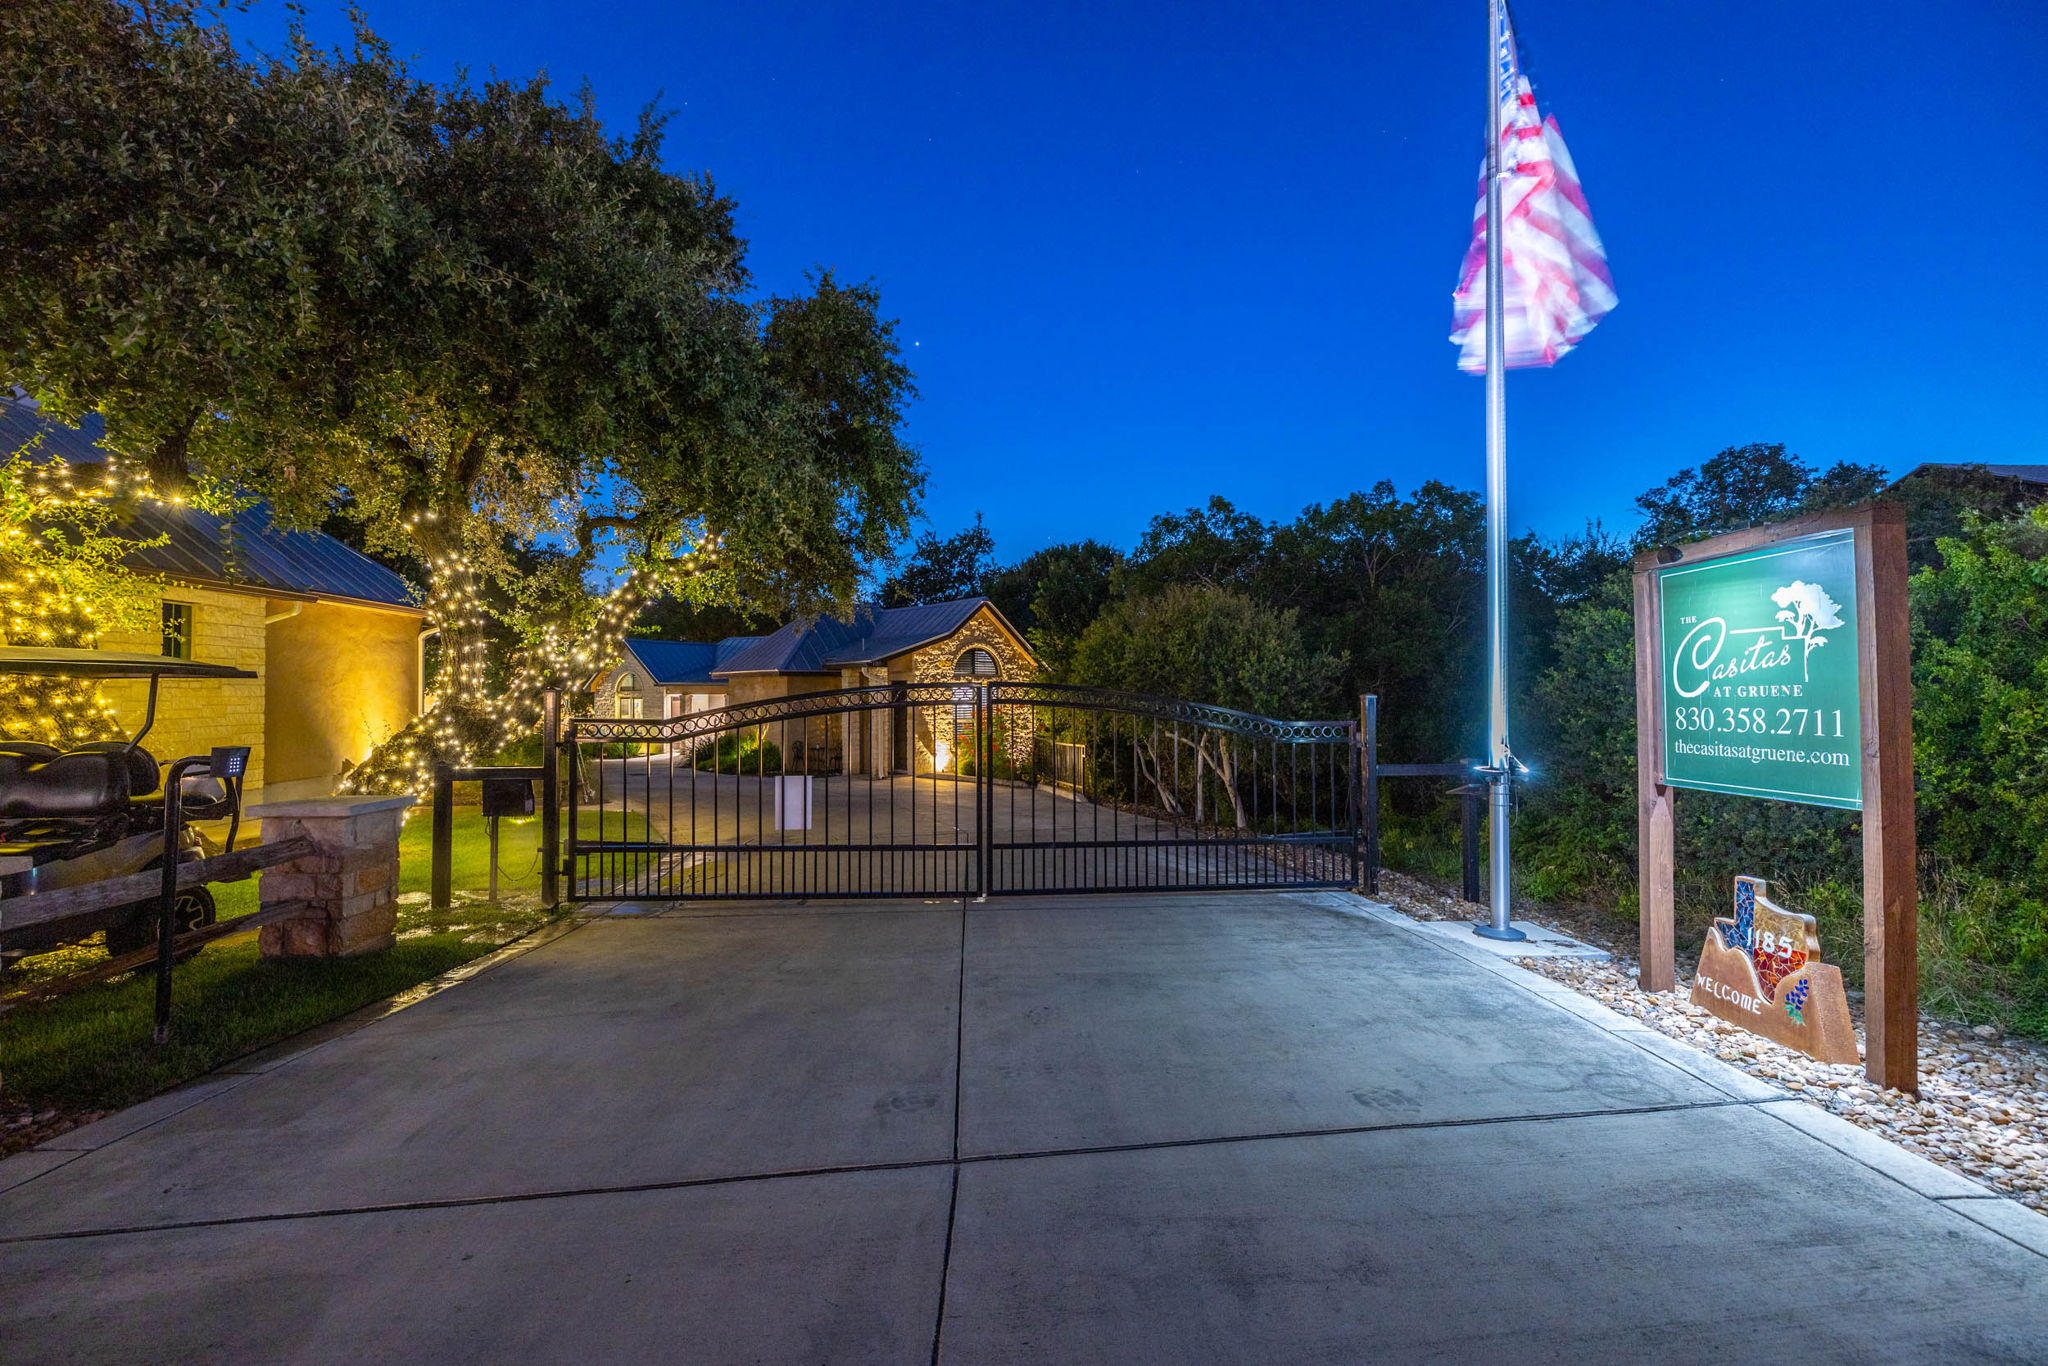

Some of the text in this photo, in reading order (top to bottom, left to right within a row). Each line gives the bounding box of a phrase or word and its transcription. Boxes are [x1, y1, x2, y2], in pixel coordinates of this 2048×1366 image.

[1680, 616, 1697, 624] THE
[1673, 617, 1792, 697] Casitas
[1713, 685, 1803, 697] AT GRUENE
[1675, 706, 1845, 737] 830.358.2711
[1674, 739, 1850, 766] thecasitasatgruene.com
[1746, 926, 1794, 959] 1185
[1696, 973, 1761, 1014] WELCOME
